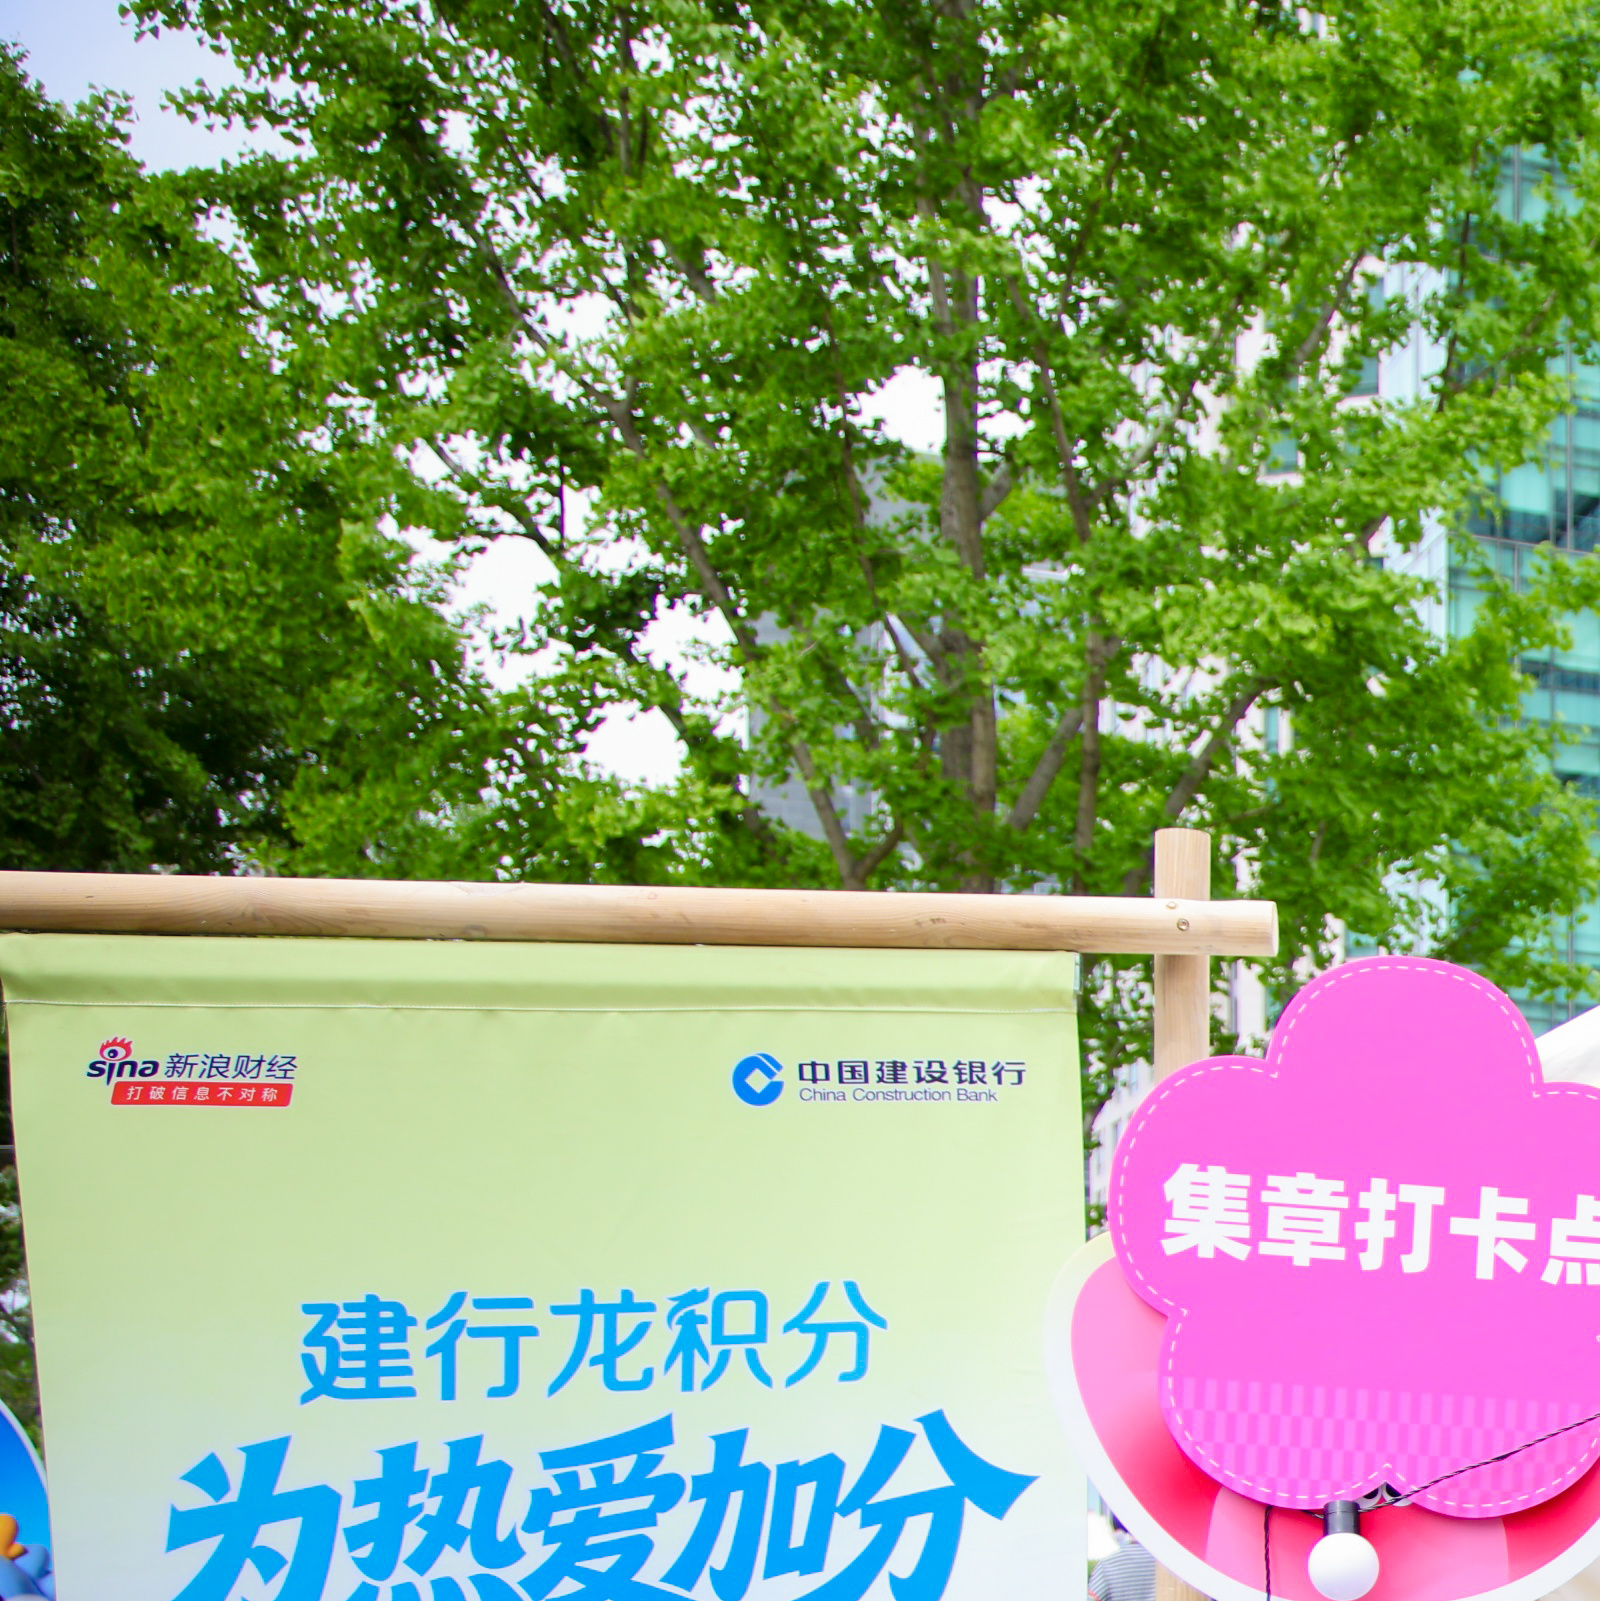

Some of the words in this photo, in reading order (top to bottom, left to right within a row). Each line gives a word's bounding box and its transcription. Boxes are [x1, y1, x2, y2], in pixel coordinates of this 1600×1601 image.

[86, 1042, 160, 1087] sina
[164, 1052, 299, 1080] 新浪财经
[798, 1059, 1027, 1086] 中国建设银行
[126, 1085, 281, 1103] 打破信息不对称
[799, 1087, 847, 1102] China
[852, 1087, 952, 1102] Construction
[956, 1087, 999, 1102] Bank
[298, 1280, 889, 1404] 建行龙积分
